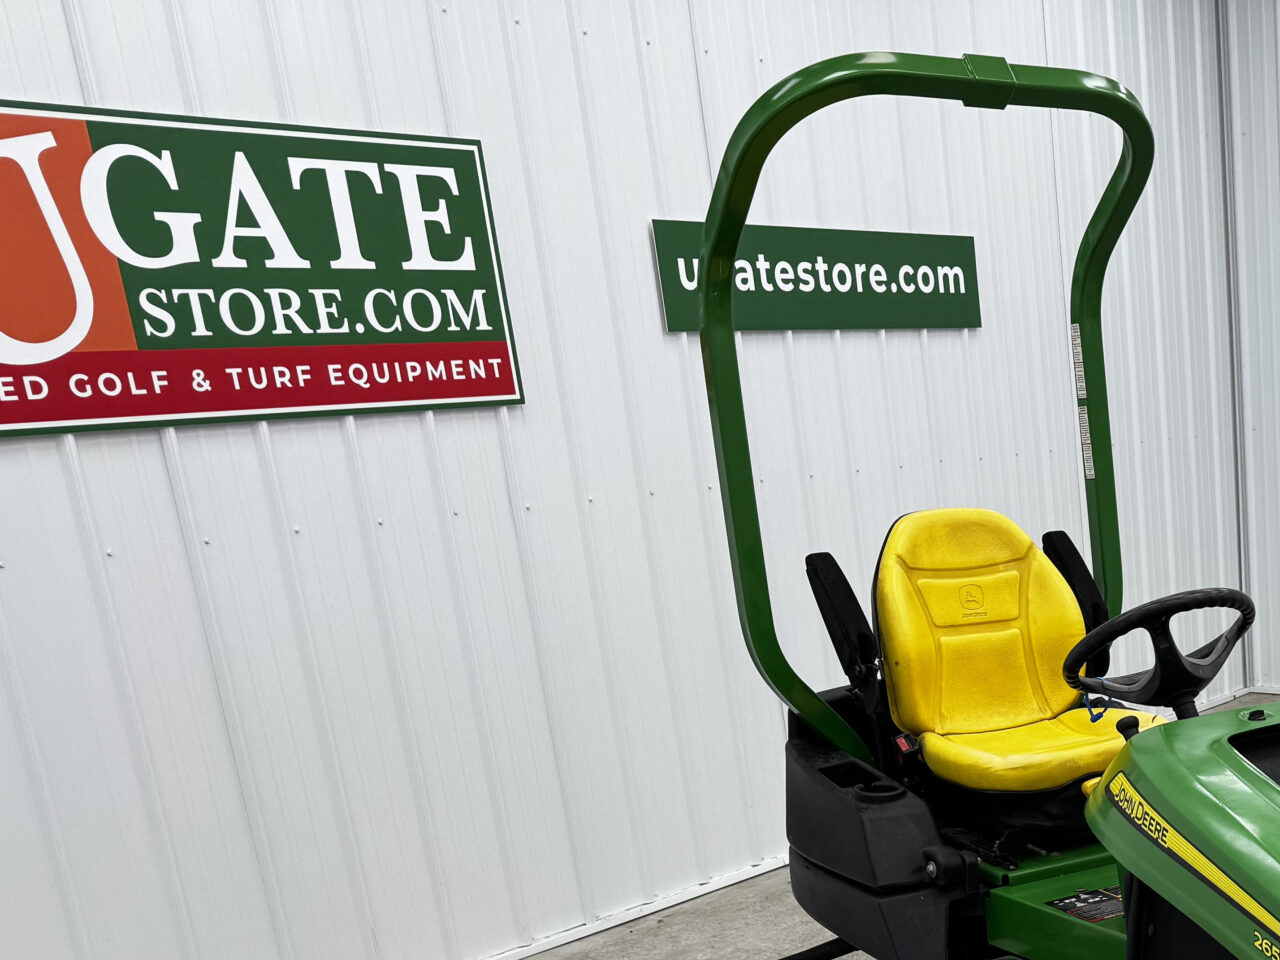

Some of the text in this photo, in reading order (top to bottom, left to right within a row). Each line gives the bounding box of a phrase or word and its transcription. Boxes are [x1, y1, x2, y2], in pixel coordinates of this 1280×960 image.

[677, 254, 966, 294] uatestore.com
[138, 287, 493, 338] STORE.COM
[69, 366, 169, 398] GOLF
[191, 369, 212, 393] &
[226, 364, 312, 390] TURF
[328, 358, 502, 387] EQUIPMENT
[1114, 782, 1169, 846] JOHN DEERE
